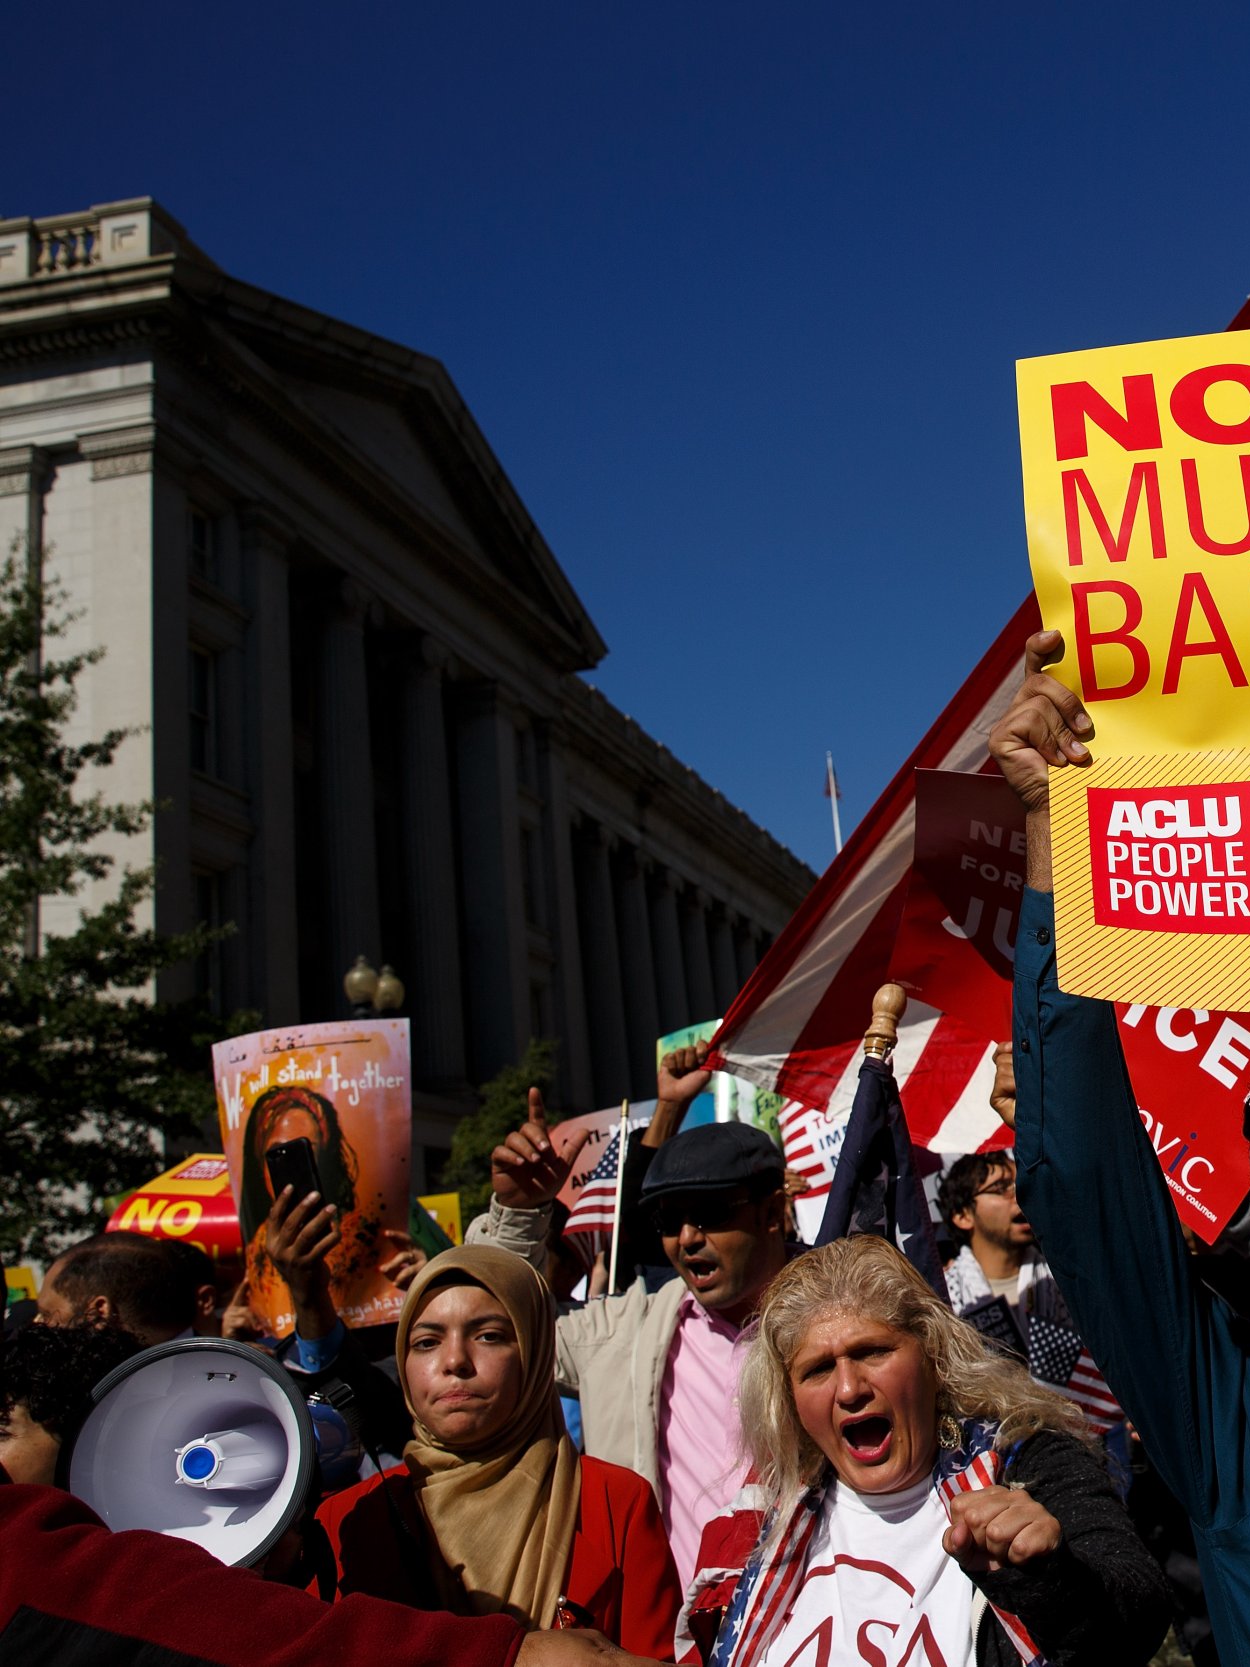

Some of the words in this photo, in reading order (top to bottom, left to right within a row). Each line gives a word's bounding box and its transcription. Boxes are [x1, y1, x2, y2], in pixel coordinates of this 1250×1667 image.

[1107, 796, 1242, 838] ACLU
[1106, 841, 1247, 877] PEOPLE
[222, 1072, 244, 1130] We
[250, 1064, 269, 1095] will
[277, 1057, 322, 1083] stand
[328, 1056, 404, 1106] together
[118, 1198, 204, 1237] NO
[1185, 1194, 1218, 1223] COALITION
